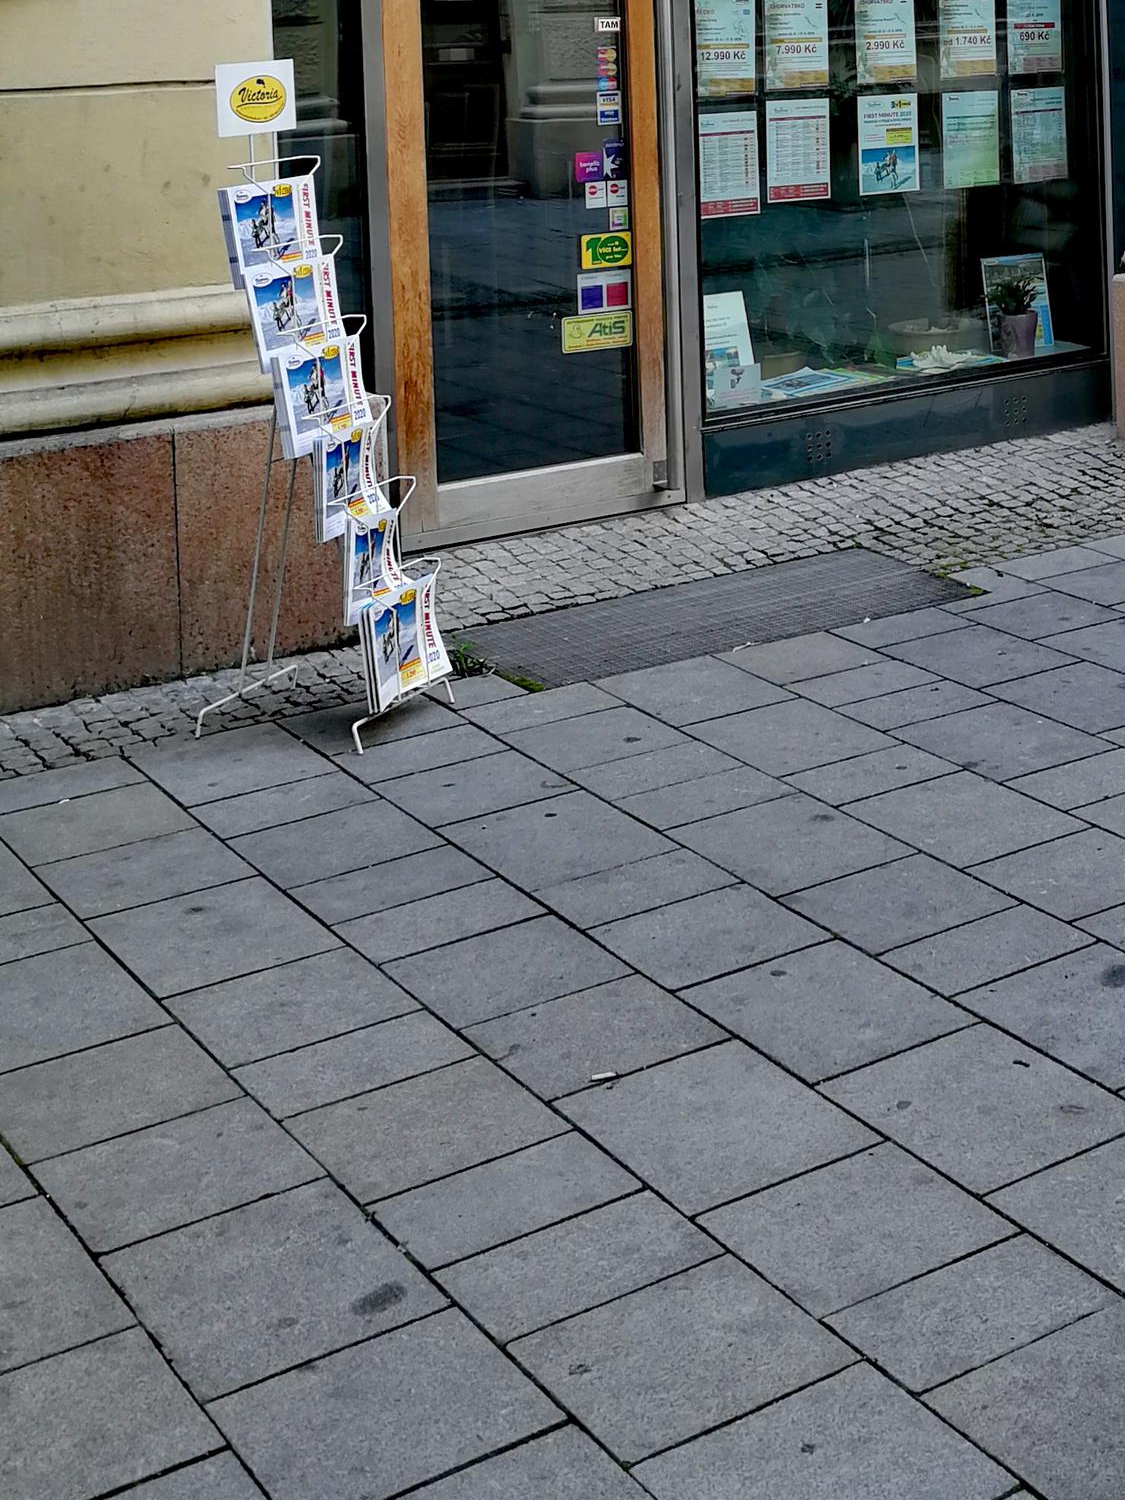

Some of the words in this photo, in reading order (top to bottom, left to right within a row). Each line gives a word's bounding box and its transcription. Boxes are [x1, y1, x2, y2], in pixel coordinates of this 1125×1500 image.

[600, 20, 619, 30] TAM
[956, 36, 977, 45] 1.740
[980, 36, 992, 45] Kč
[1019, 32, 1035, 41] 690
[1037, 31, 1050, 41] Kč
[776, 45, 802, 54] 7.990
[804, 45, 817, 54] Kč
[865, 41, 890, 50] 2.990
[892, 40, 904, 49] Kč
[700, 51, 731, 61] 12.990
[733, 51, 746, 60] Kč
[238, 87, 279, 103] Victoria
